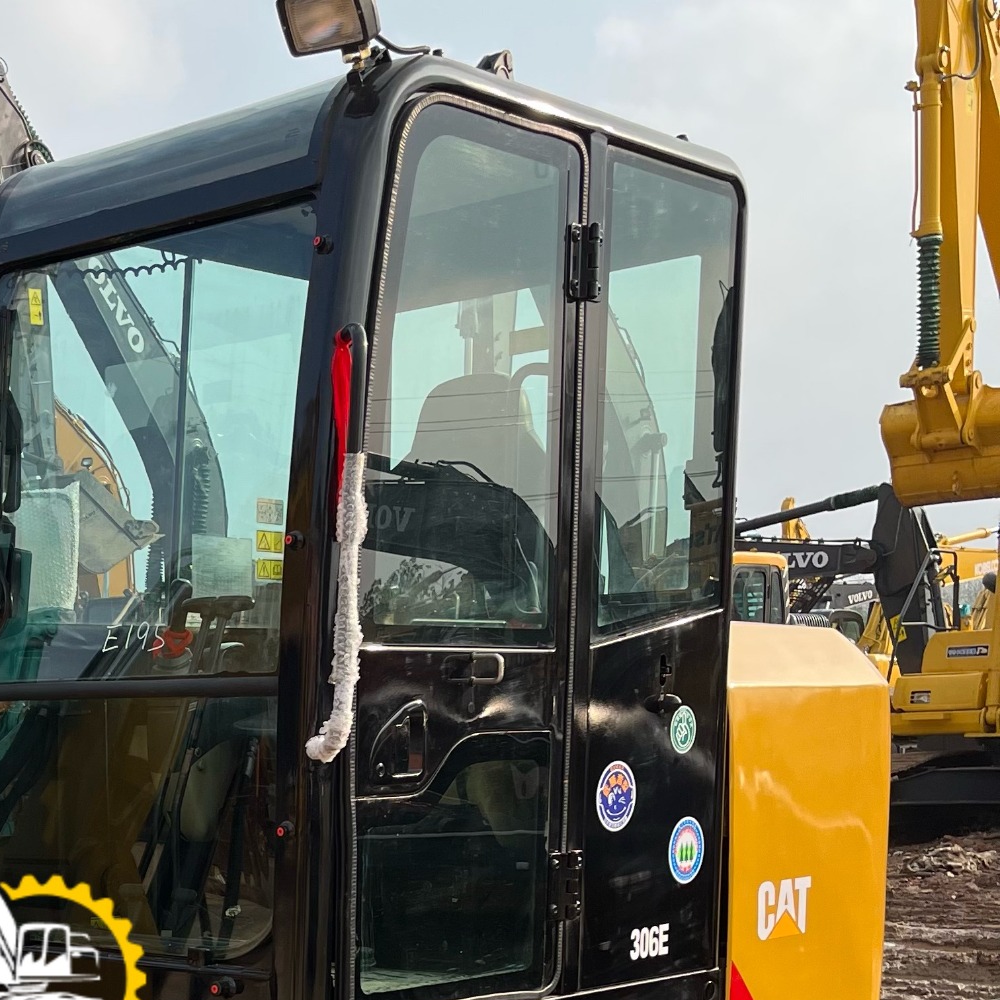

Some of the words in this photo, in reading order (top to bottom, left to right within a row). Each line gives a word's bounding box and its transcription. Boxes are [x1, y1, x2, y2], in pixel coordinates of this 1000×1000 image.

[88, 257, 145, 353] OLVO
[786, 551, 829, 568] LVO
[848, 590, 873, 604] VOLVO
[102, 621, 165, 653] E195
[757, 875, 811, 941] CAT
[630, 923, 669, 960] 306E
